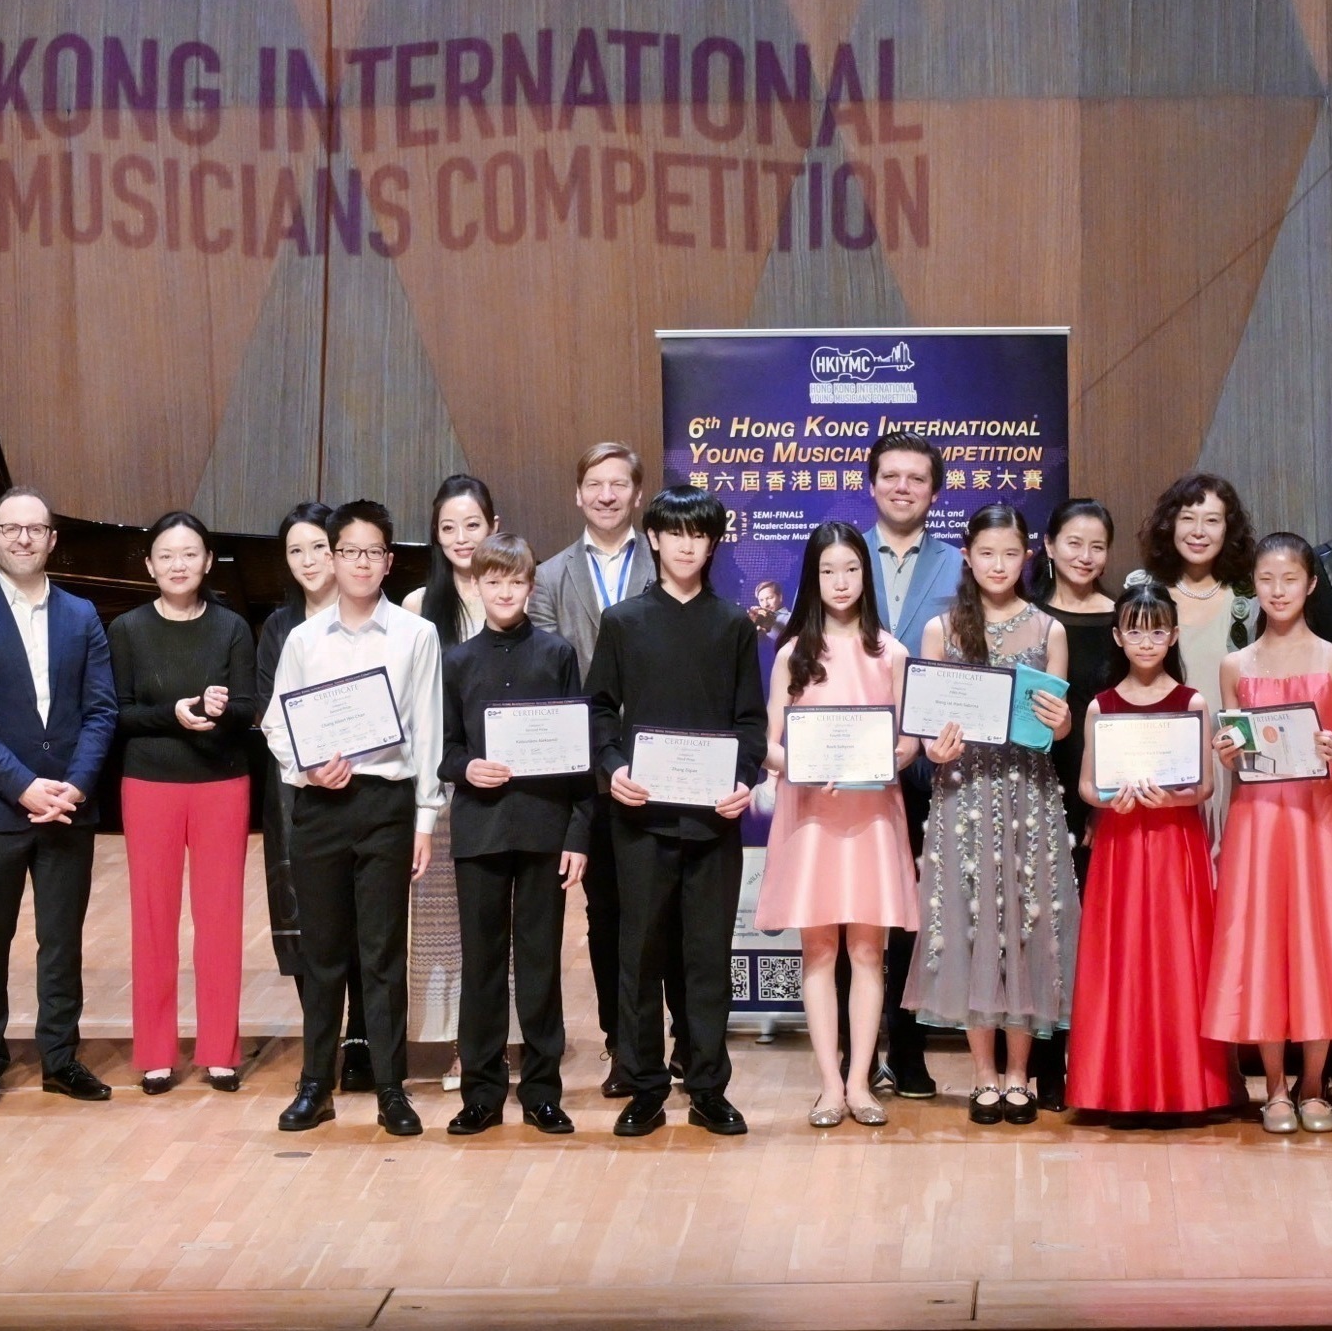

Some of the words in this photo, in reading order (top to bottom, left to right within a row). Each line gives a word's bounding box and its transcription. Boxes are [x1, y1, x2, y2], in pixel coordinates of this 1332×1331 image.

[260, 28, 923, 151] INTERNATIONAL
[436, 149, 929, 254] COMPETITION
[816, 356, 870, 373] HKIYMC
[810, 383, 832, 393] HONG
[834, 383, 855, 393] KONG
[856, 383, 915, 393] INTERNATIONAL
[810, 393, 833, 403] YOUNG
[835, 393, 871, 403] MUSICIANS
[872, 393, 917, 403] COMPETITION
[688, 417, 721, 438] 6th
[730, 417, 795, 438] HONG
[804, 416, 869, 437] KONG
[877, 416, 1041, 437] INTERNATIONAL
[690, 443, 764, 464] YOUNG
[773, 442, 872, 463] MUSICIA
[939, 446, 1043, 462] MPETITION
[753, 511, 804, 519] SEMI-FINALS
[927, 510, 945, 518] NAL
[947, 509, 965, 517] and
[753, 522, 808, 530] Masterclasses
[720, 533, 738, 543] 26
[753, 533, 790, 541] Chamber
[792, 533, 810, 541] Musi
[937, 671, 983, 682] CERTIFICATE
[313, 684, 359, 701] CERTIFICATE
[512, 708, 560, 717] CERTIFICATE
[816, 714, 863, 722] CERTIFICATE
[664, 737, 711, 747] CERTIFICATE
